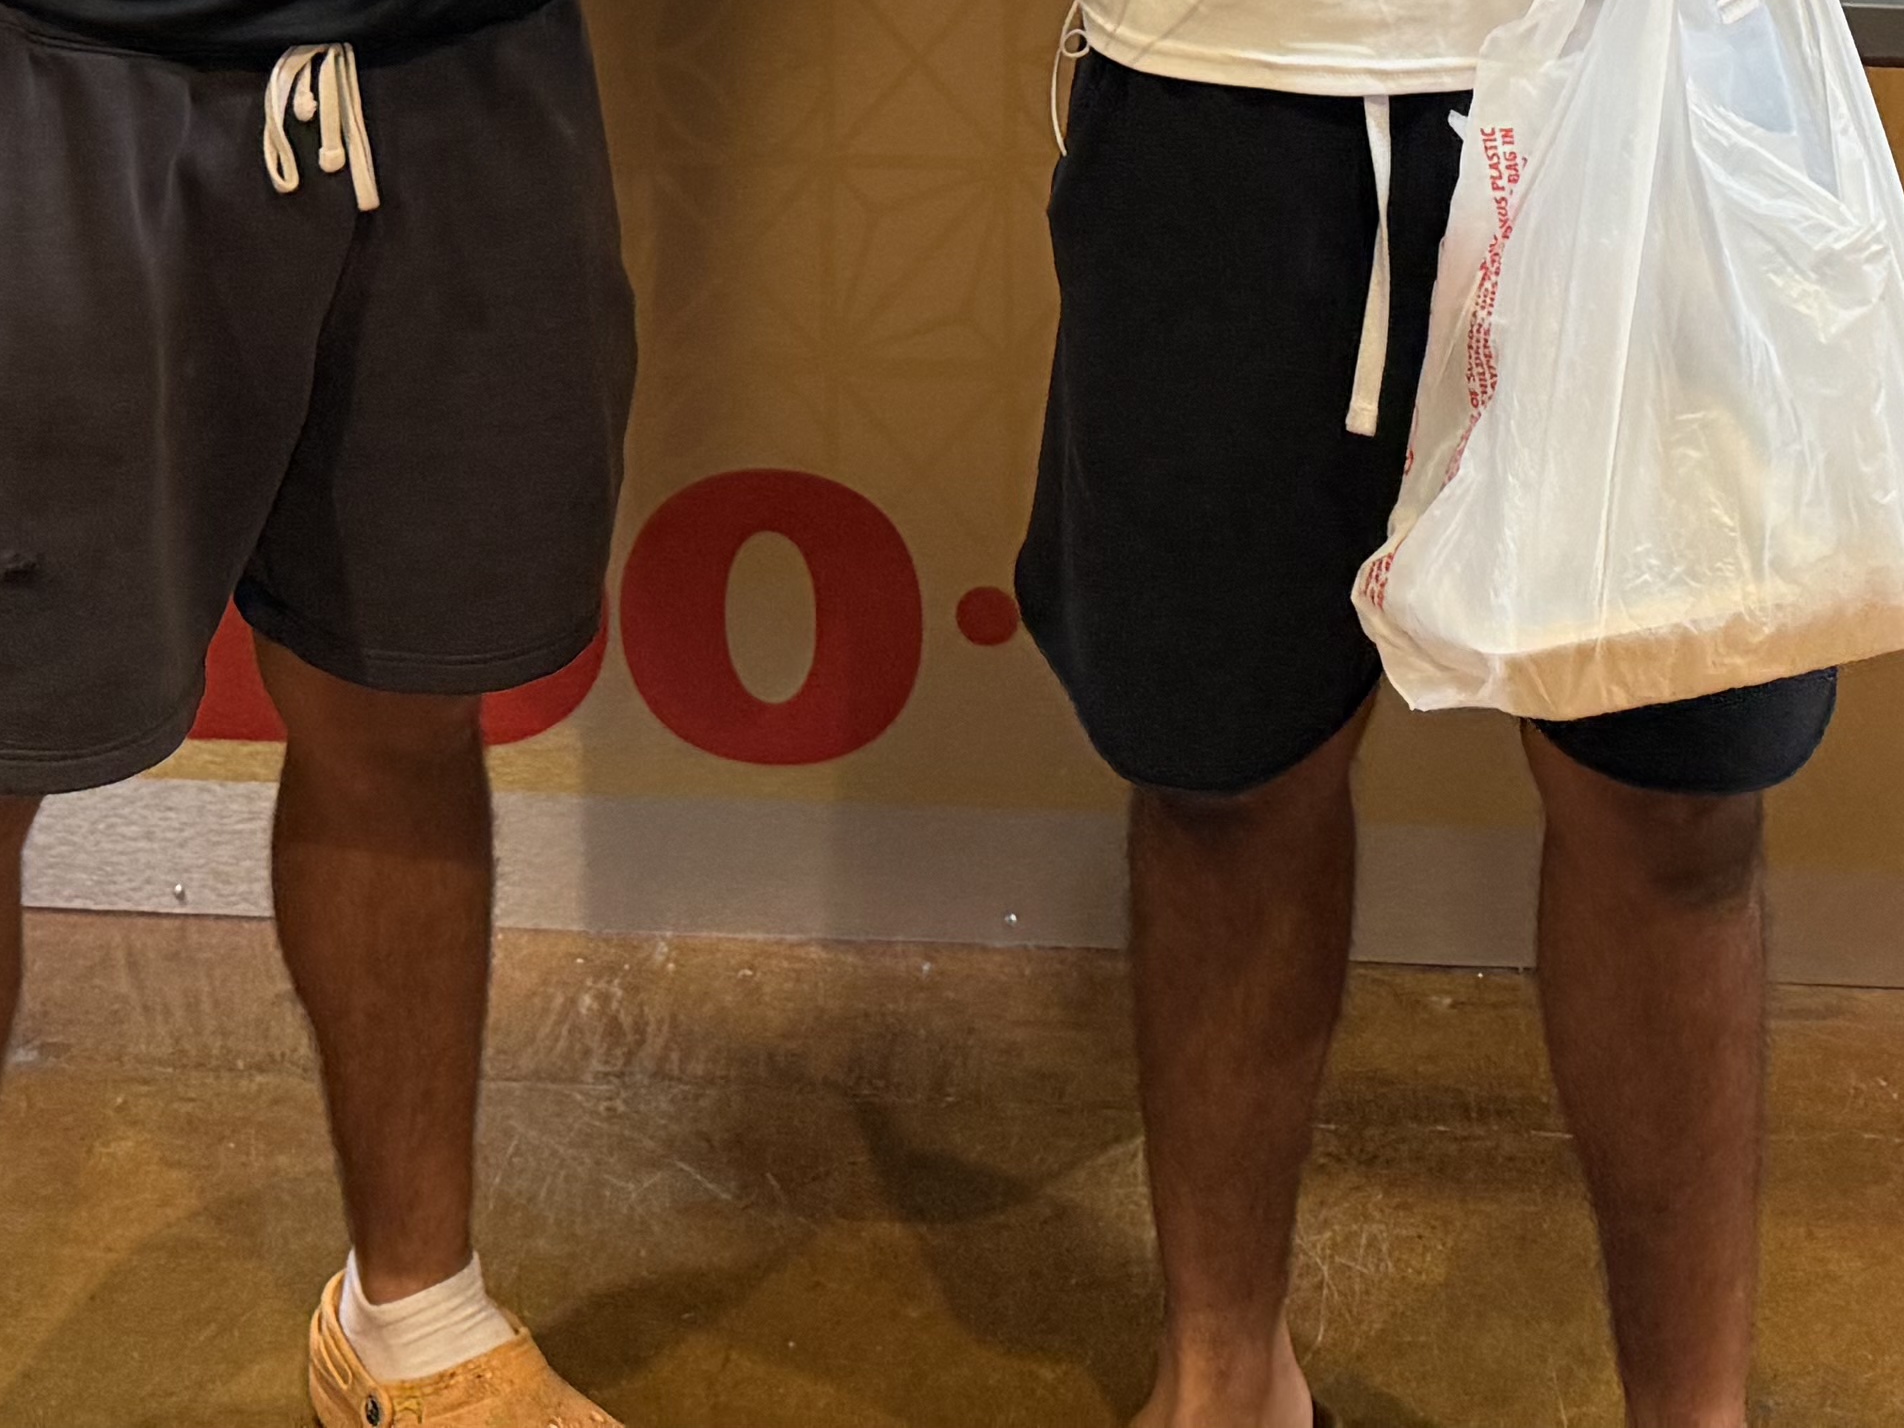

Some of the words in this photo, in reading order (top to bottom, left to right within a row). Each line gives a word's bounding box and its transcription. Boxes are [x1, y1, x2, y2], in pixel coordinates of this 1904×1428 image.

[1499, 127, 1515, 147] IN
[1480, 126, 1506, 193] PLASTIC
[1503, 151, 1521, 185] BAG
